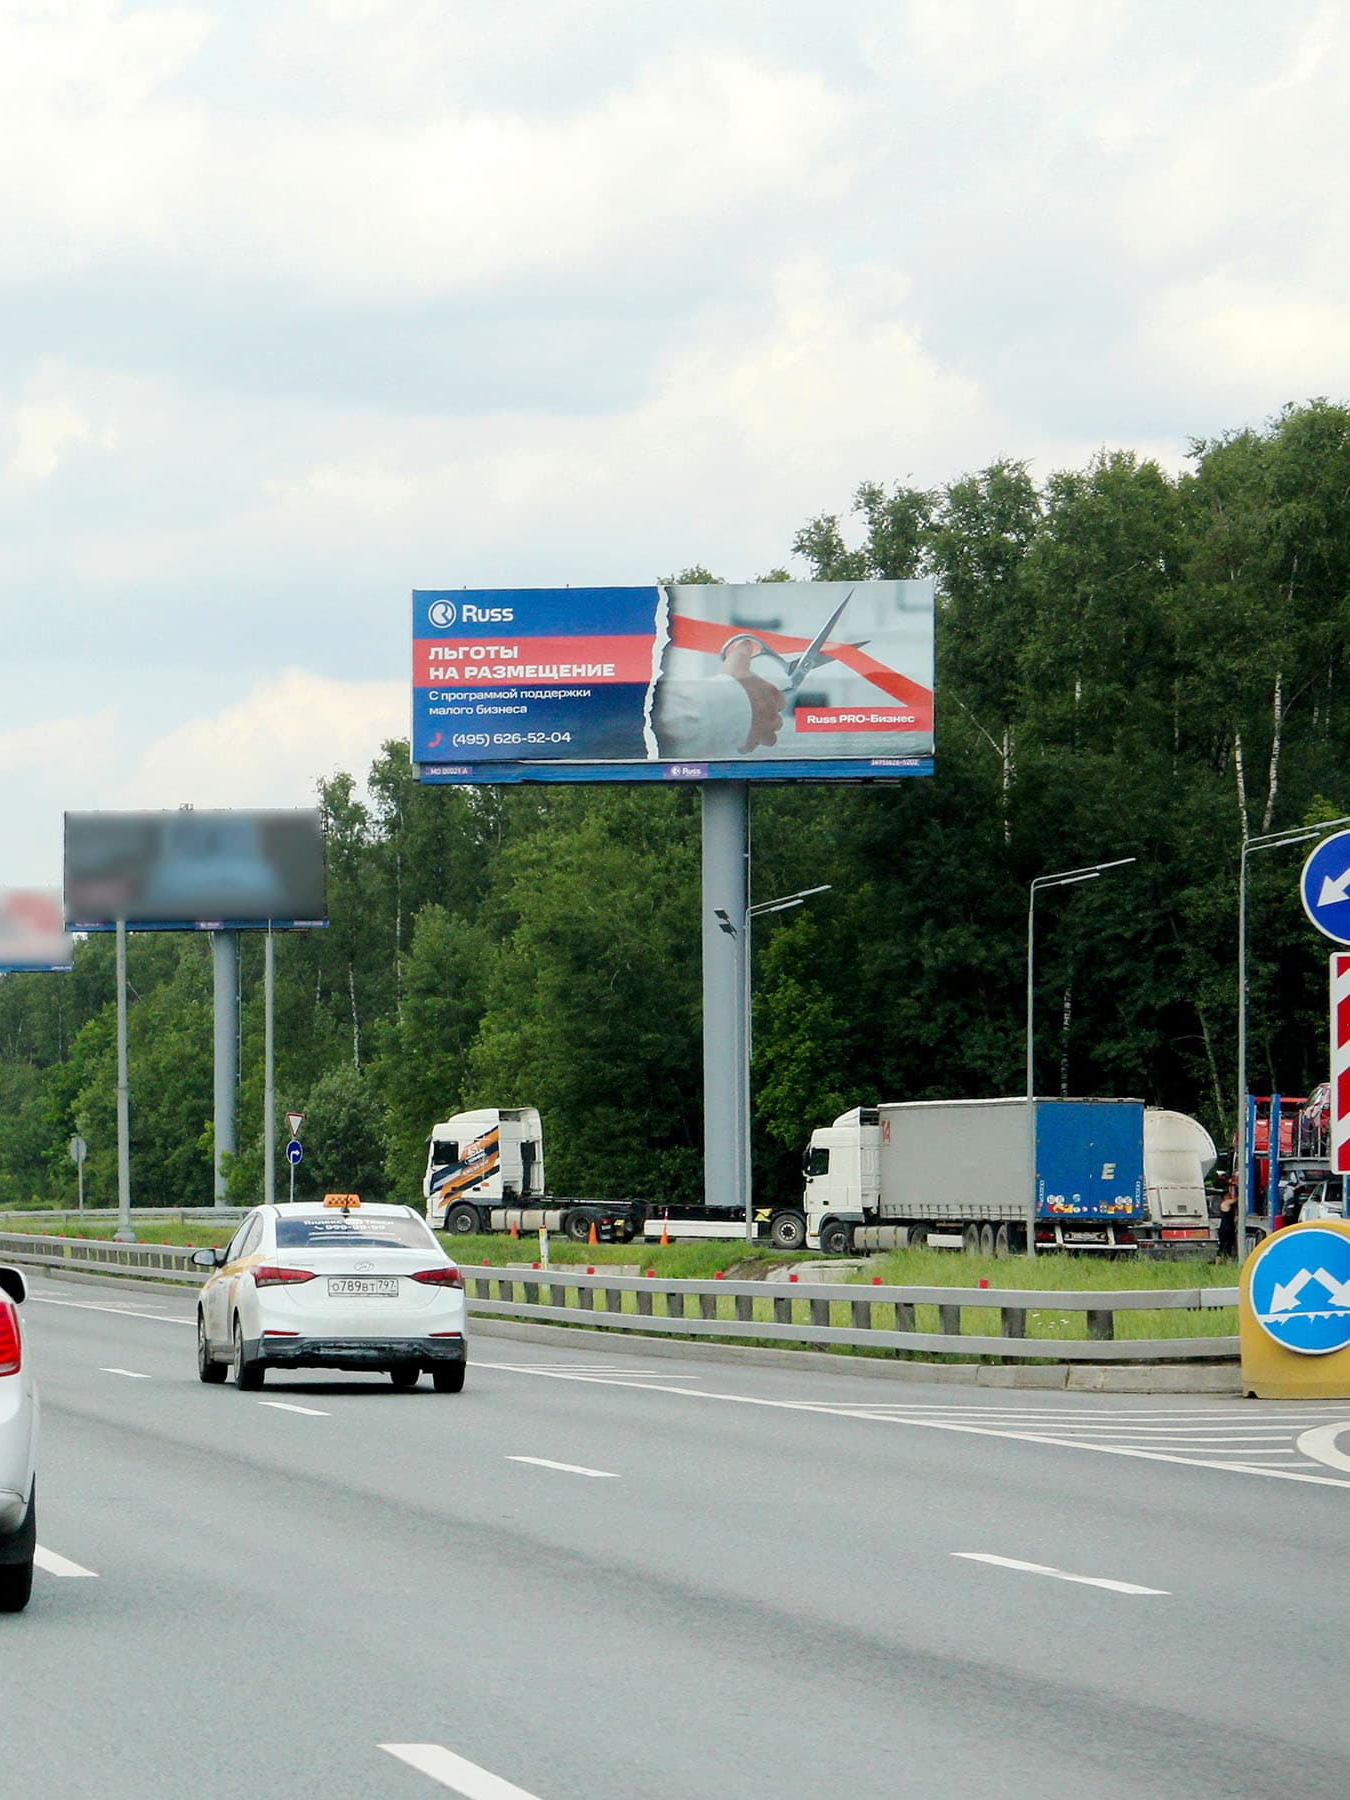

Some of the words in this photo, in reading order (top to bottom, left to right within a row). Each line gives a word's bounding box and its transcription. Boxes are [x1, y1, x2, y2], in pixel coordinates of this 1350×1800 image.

[462, 604, 514, 623] Russ
[428, 645, 519, 660] ЛЬГОТЫ
[429, 666, 460, 680] НА
[464, 663, 616, 680] РАЗМЕЩЕНИЕ
[428, 690, 439, 701] С
[441, 688, 518, 703] программой
[519, 688, 591, 700] поддержки
[429, 706, 474, 716] малого
[476, 704, 528, 715] бизнеса
[807, 714, 837, 724] Russ
[839, 713, 915, 723] PRO-Бизнес
[452, 732, 490, 747] (495)
[493, 731, 572, 745] 626-52-04
